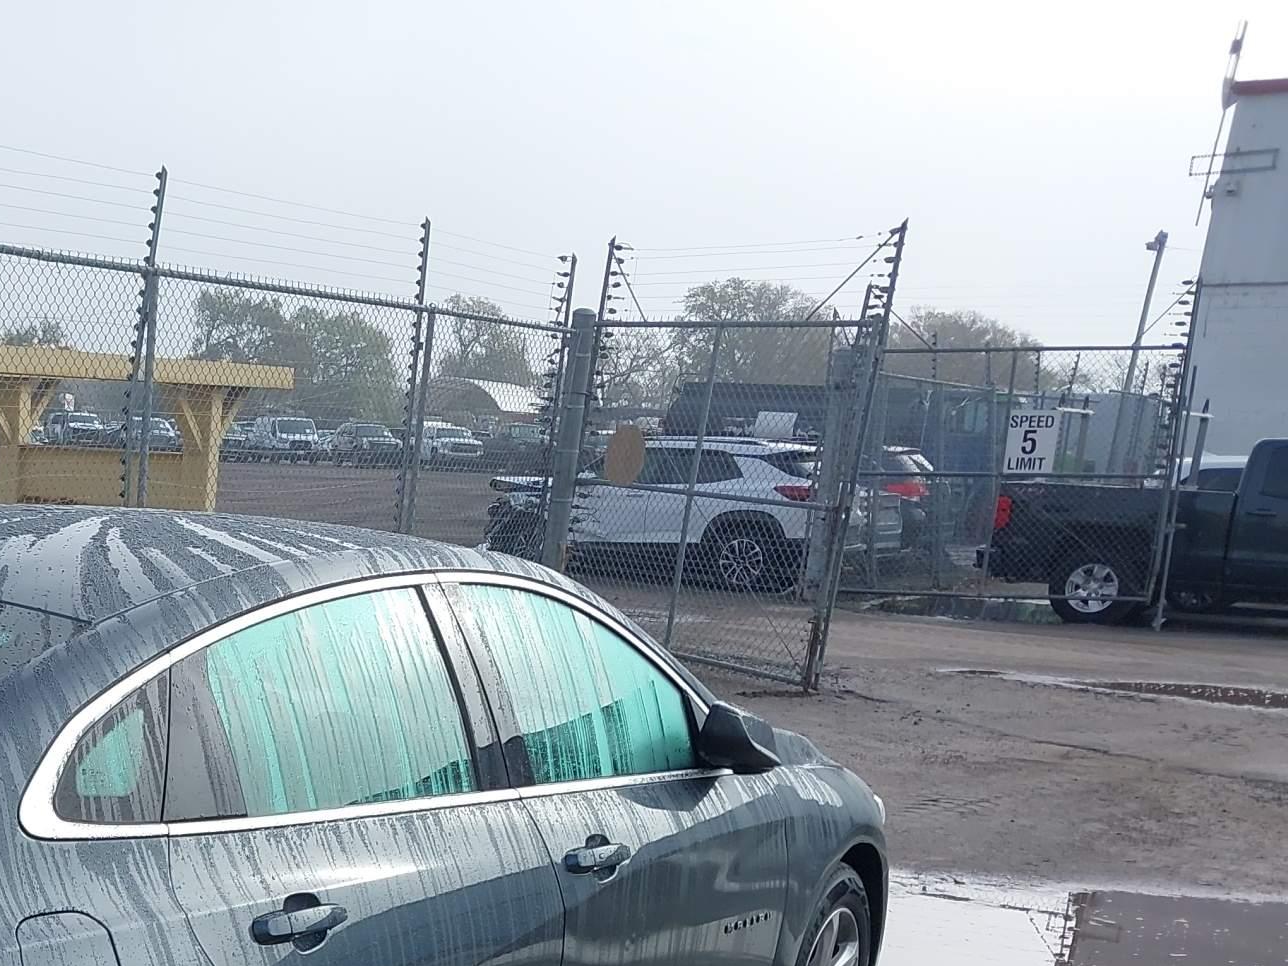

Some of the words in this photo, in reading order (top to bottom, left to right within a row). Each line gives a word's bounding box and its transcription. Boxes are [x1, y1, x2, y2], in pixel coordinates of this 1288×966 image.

[1010, 415, 1055, 428] SPEED
[1021, 429, 1037, 455] 5
[1007, 457, 1046, 470] LIMIT
